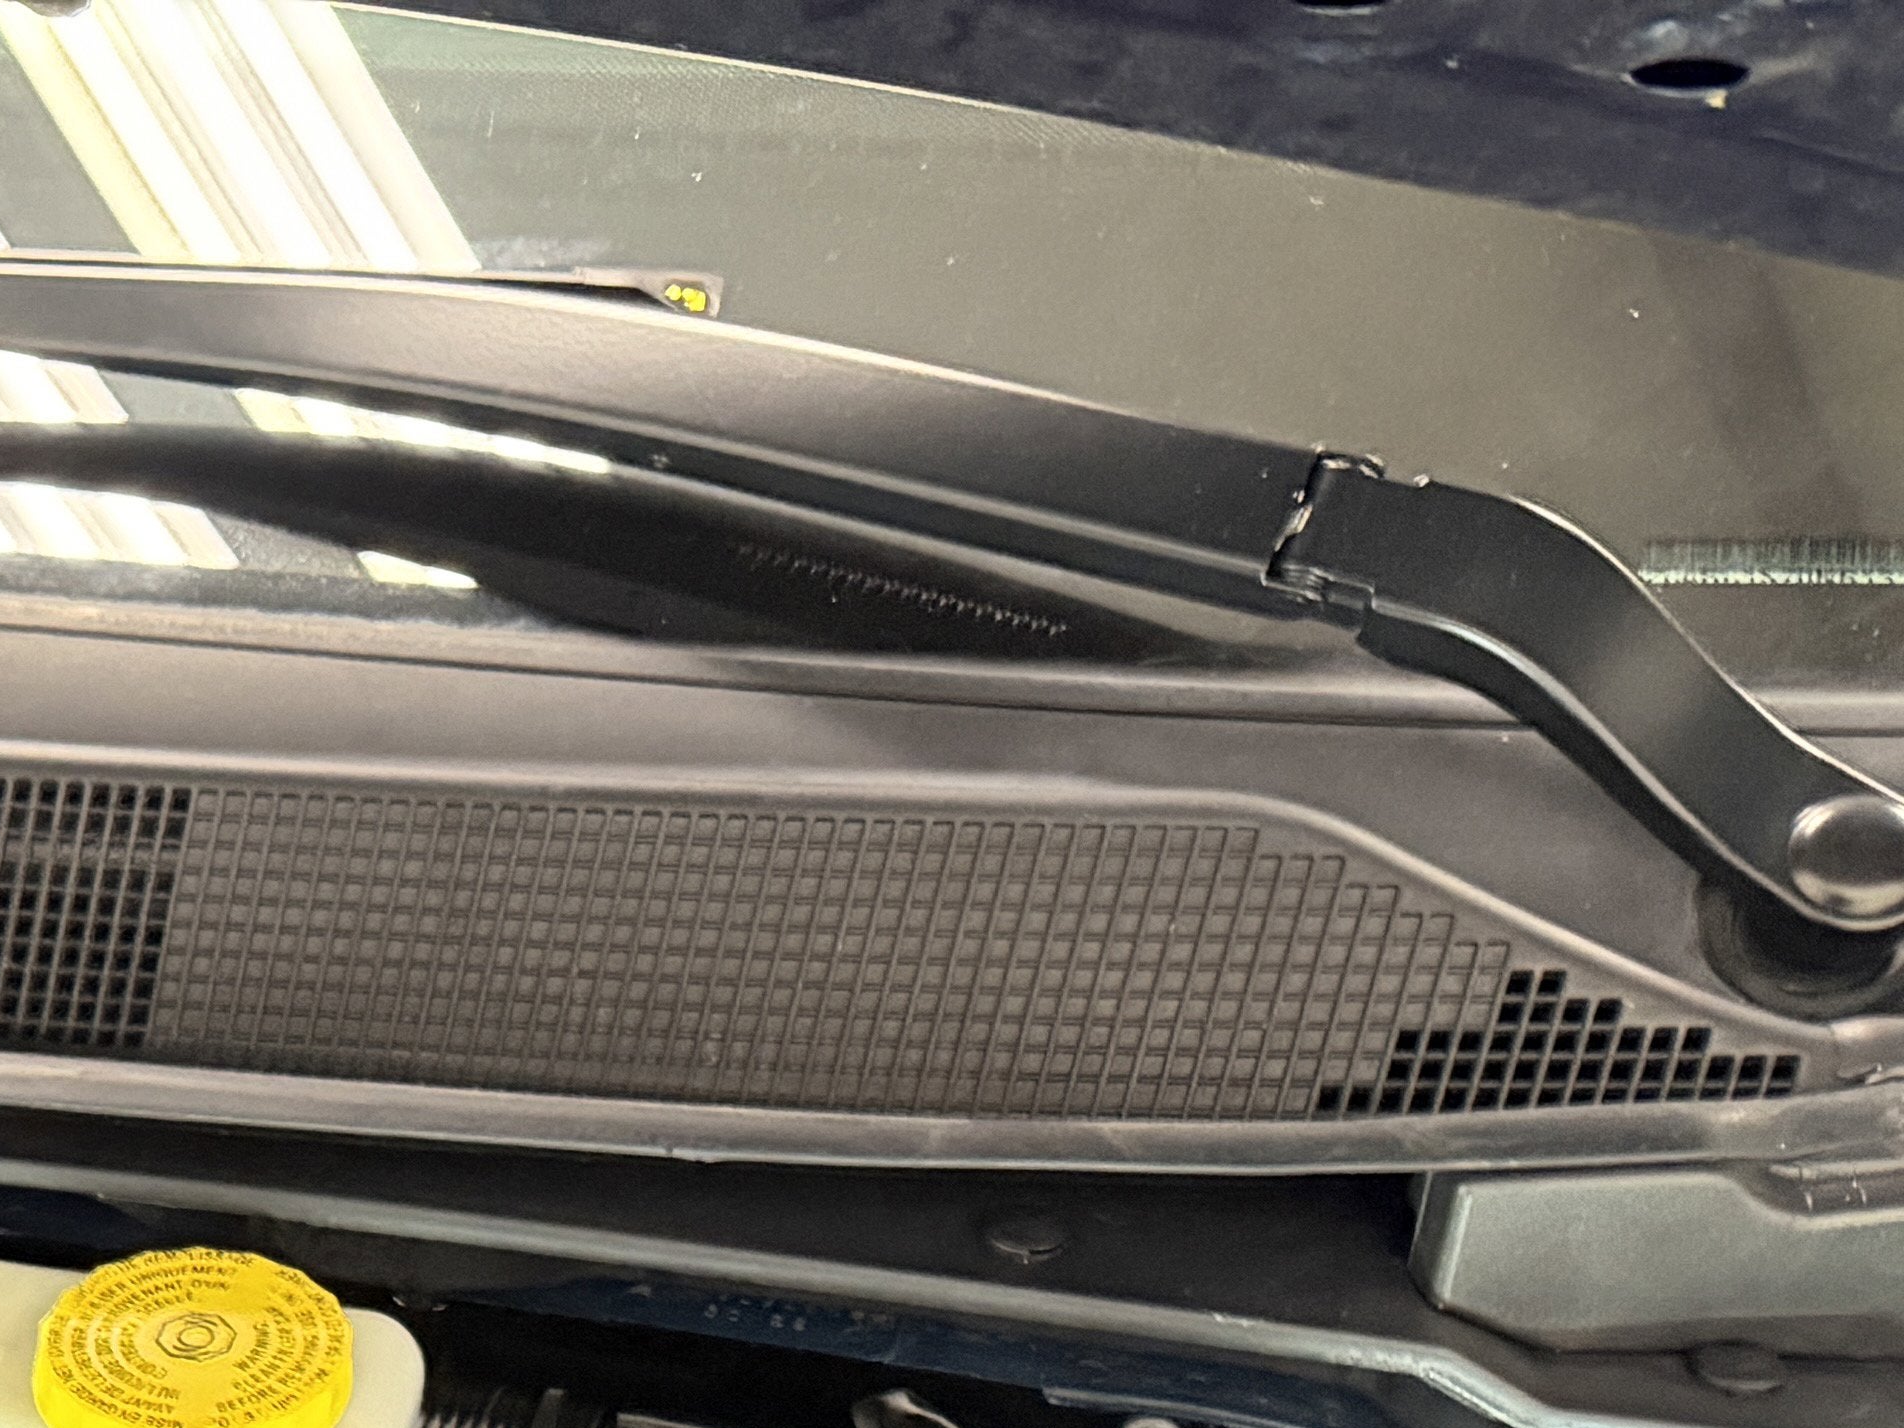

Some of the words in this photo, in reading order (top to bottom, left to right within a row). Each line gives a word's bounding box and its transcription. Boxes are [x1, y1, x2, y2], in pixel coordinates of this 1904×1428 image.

[98, 1382, 126, 1399] DE
[229, 1360, 284, 1395] CLEAN
[64, 1380, 121, 1417] GARDE
[120, 1393, 175, 1416] AVANT
[213, 1383, 283, 1413] BEFORE
[114, 1408, 143, 1424] EN
